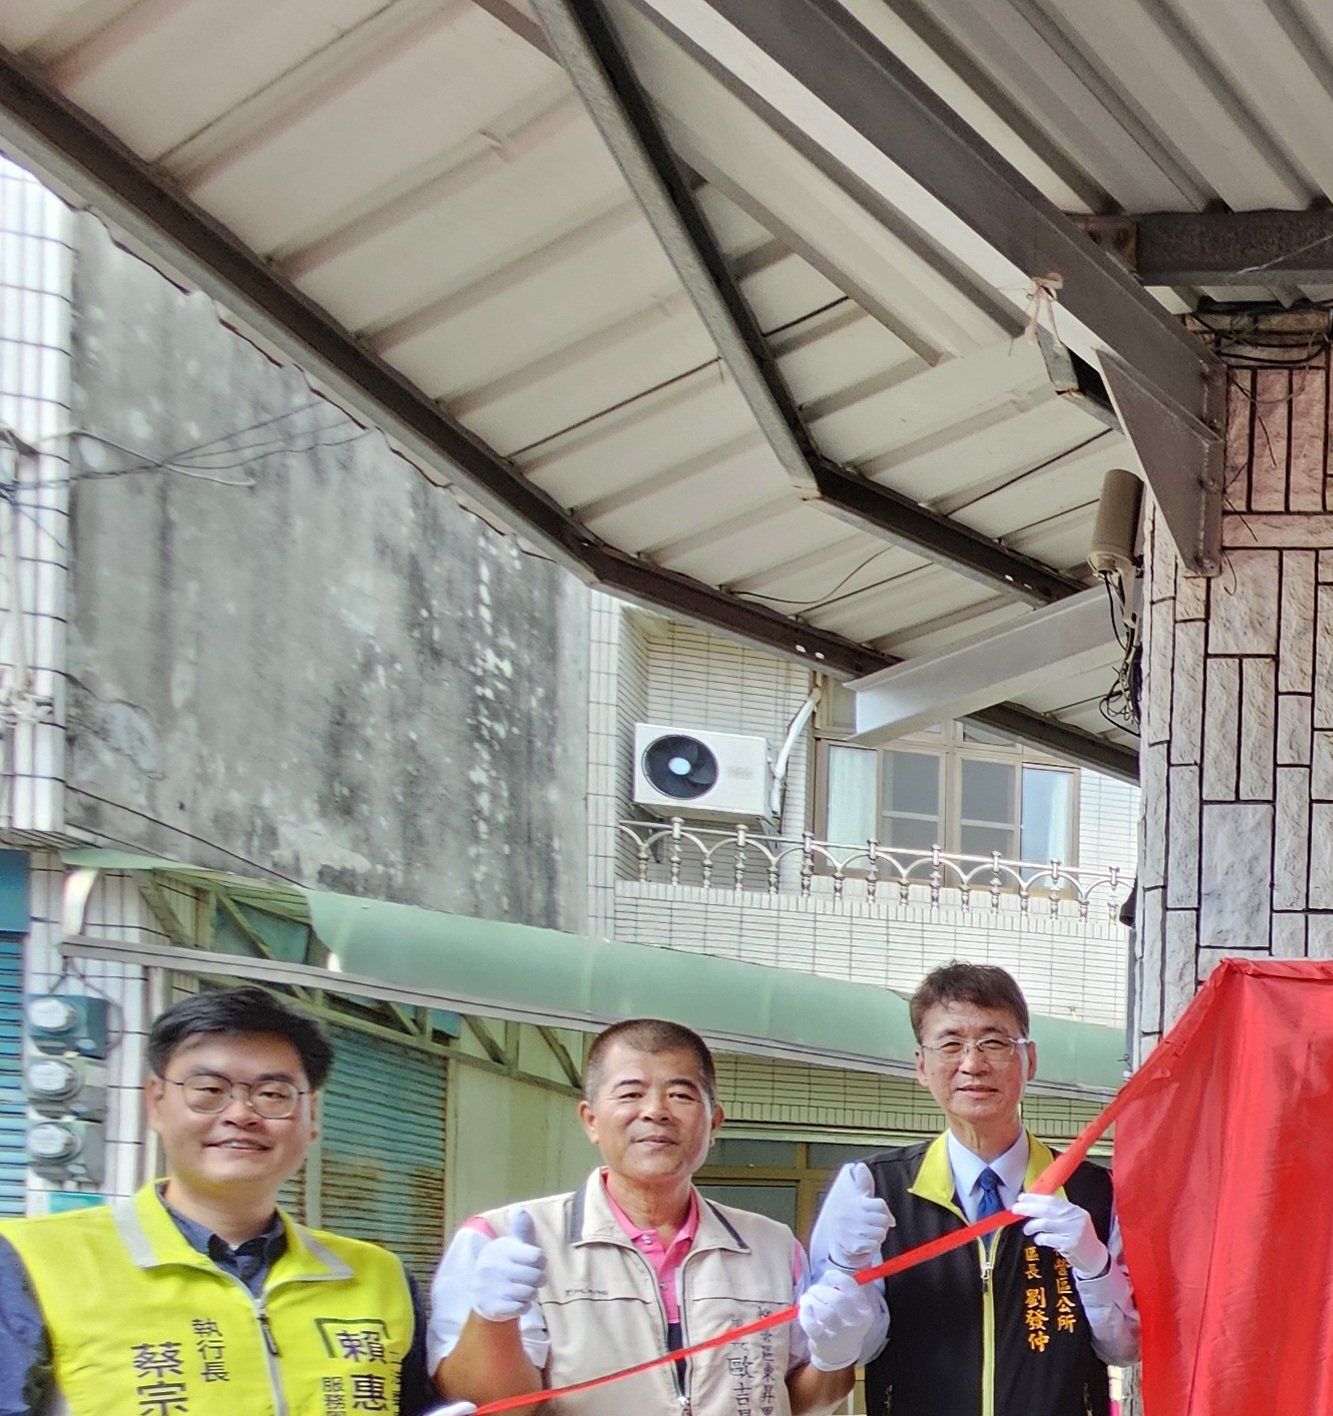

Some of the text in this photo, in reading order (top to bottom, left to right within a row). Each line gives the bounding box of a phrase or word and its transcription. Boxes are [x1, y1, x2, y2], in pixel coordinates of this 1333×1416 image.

[1024, 1246, 1042, 1279] 區長
[1054, 1248, 1077, 1333] 營區公所
[191, 1318, 231, 1383] 執行長
